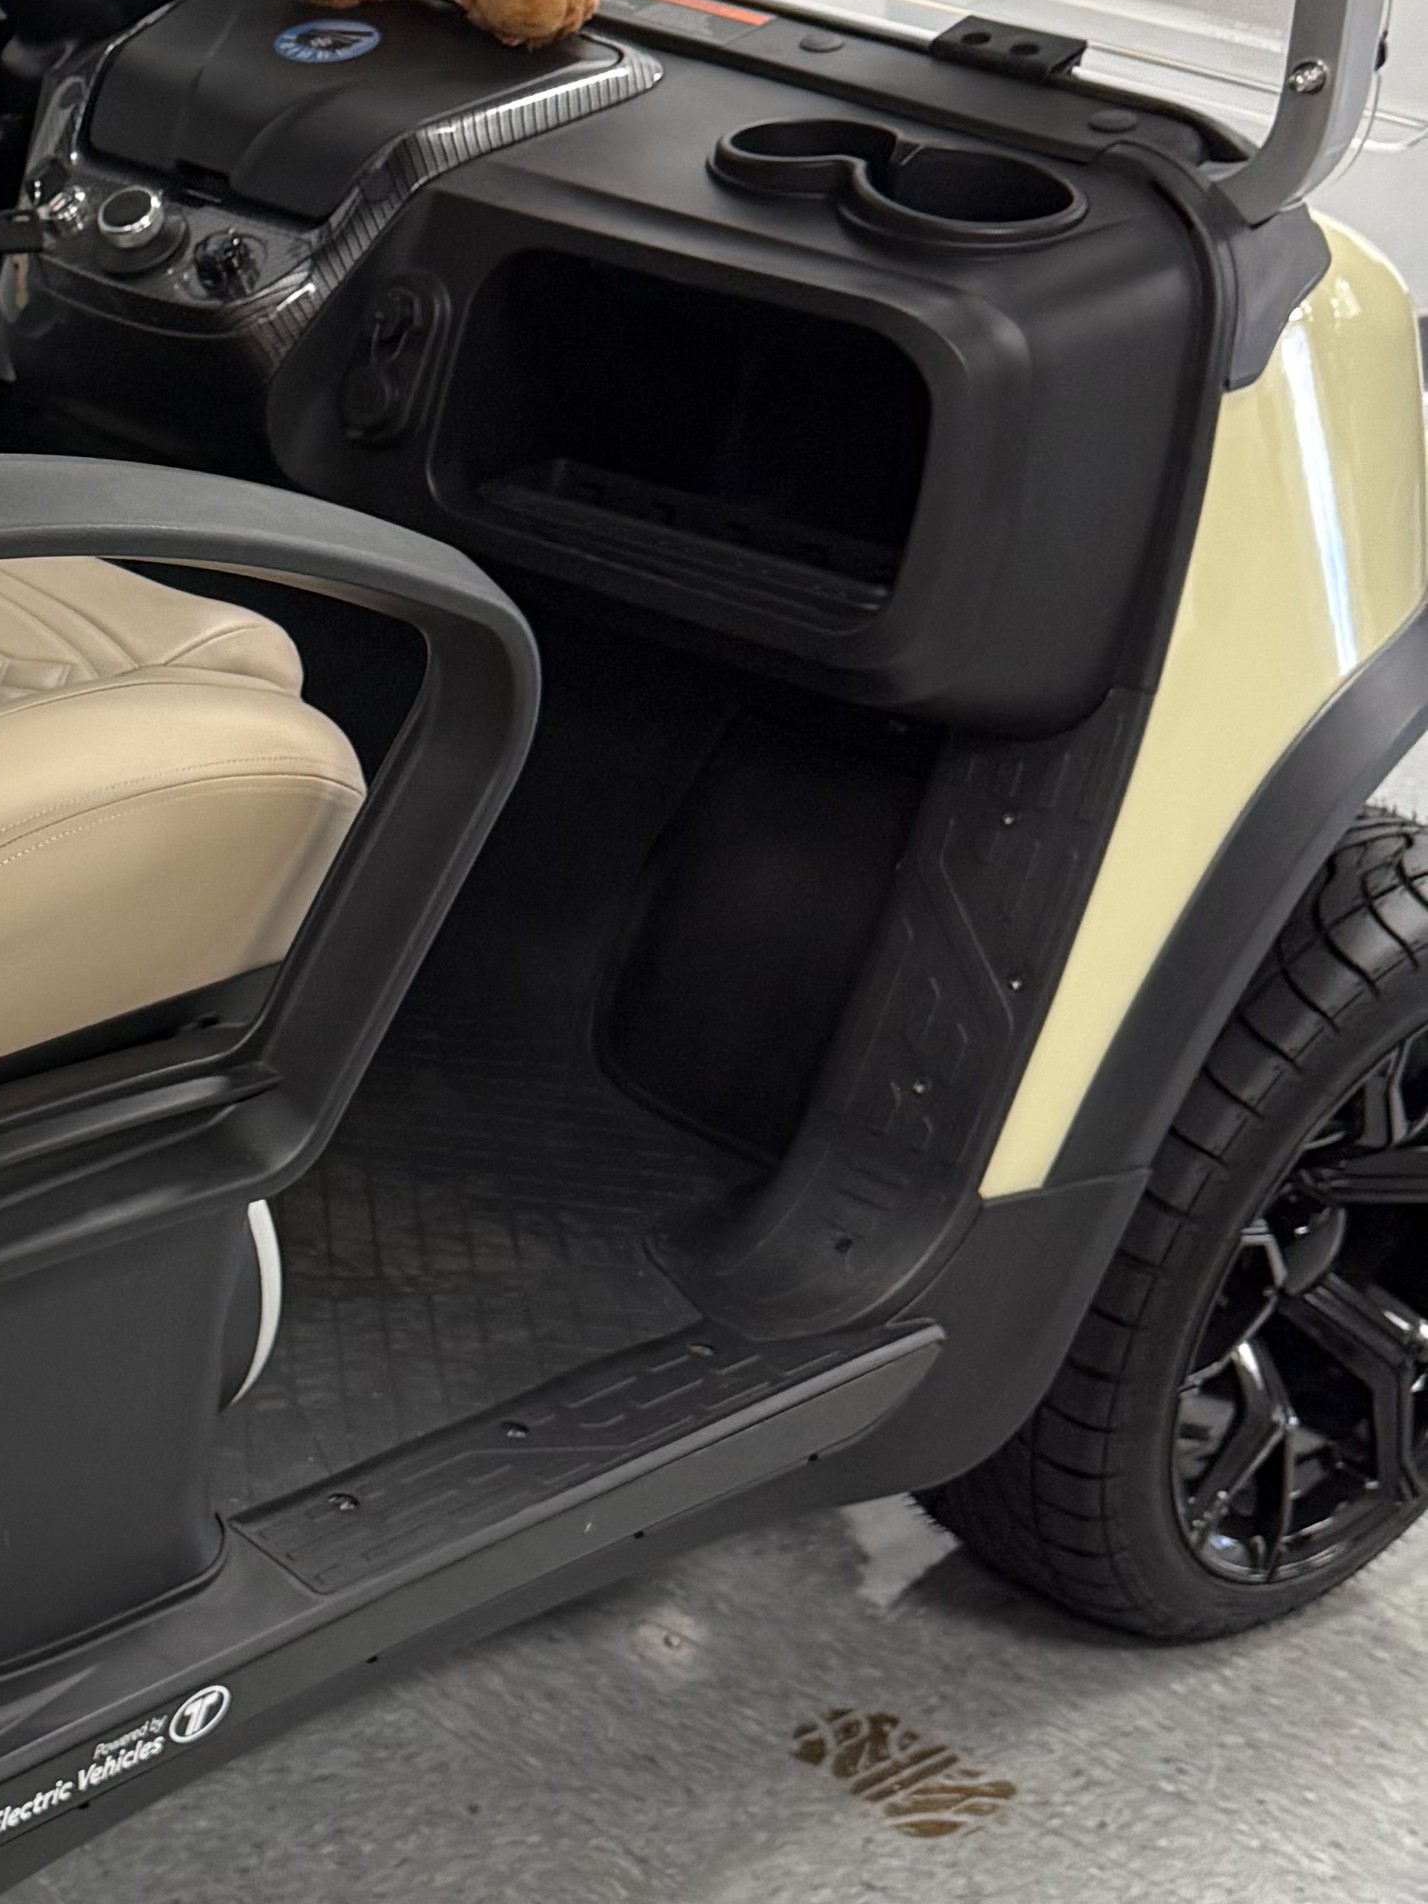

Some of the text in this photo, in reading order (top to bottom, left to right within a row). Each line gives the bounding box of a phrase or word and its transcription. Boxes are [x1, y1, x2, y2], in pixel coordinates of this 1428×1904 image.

[93, 1714, 169, 1760] Powered by
[78, 1736, 166, 1791] Vehicles
